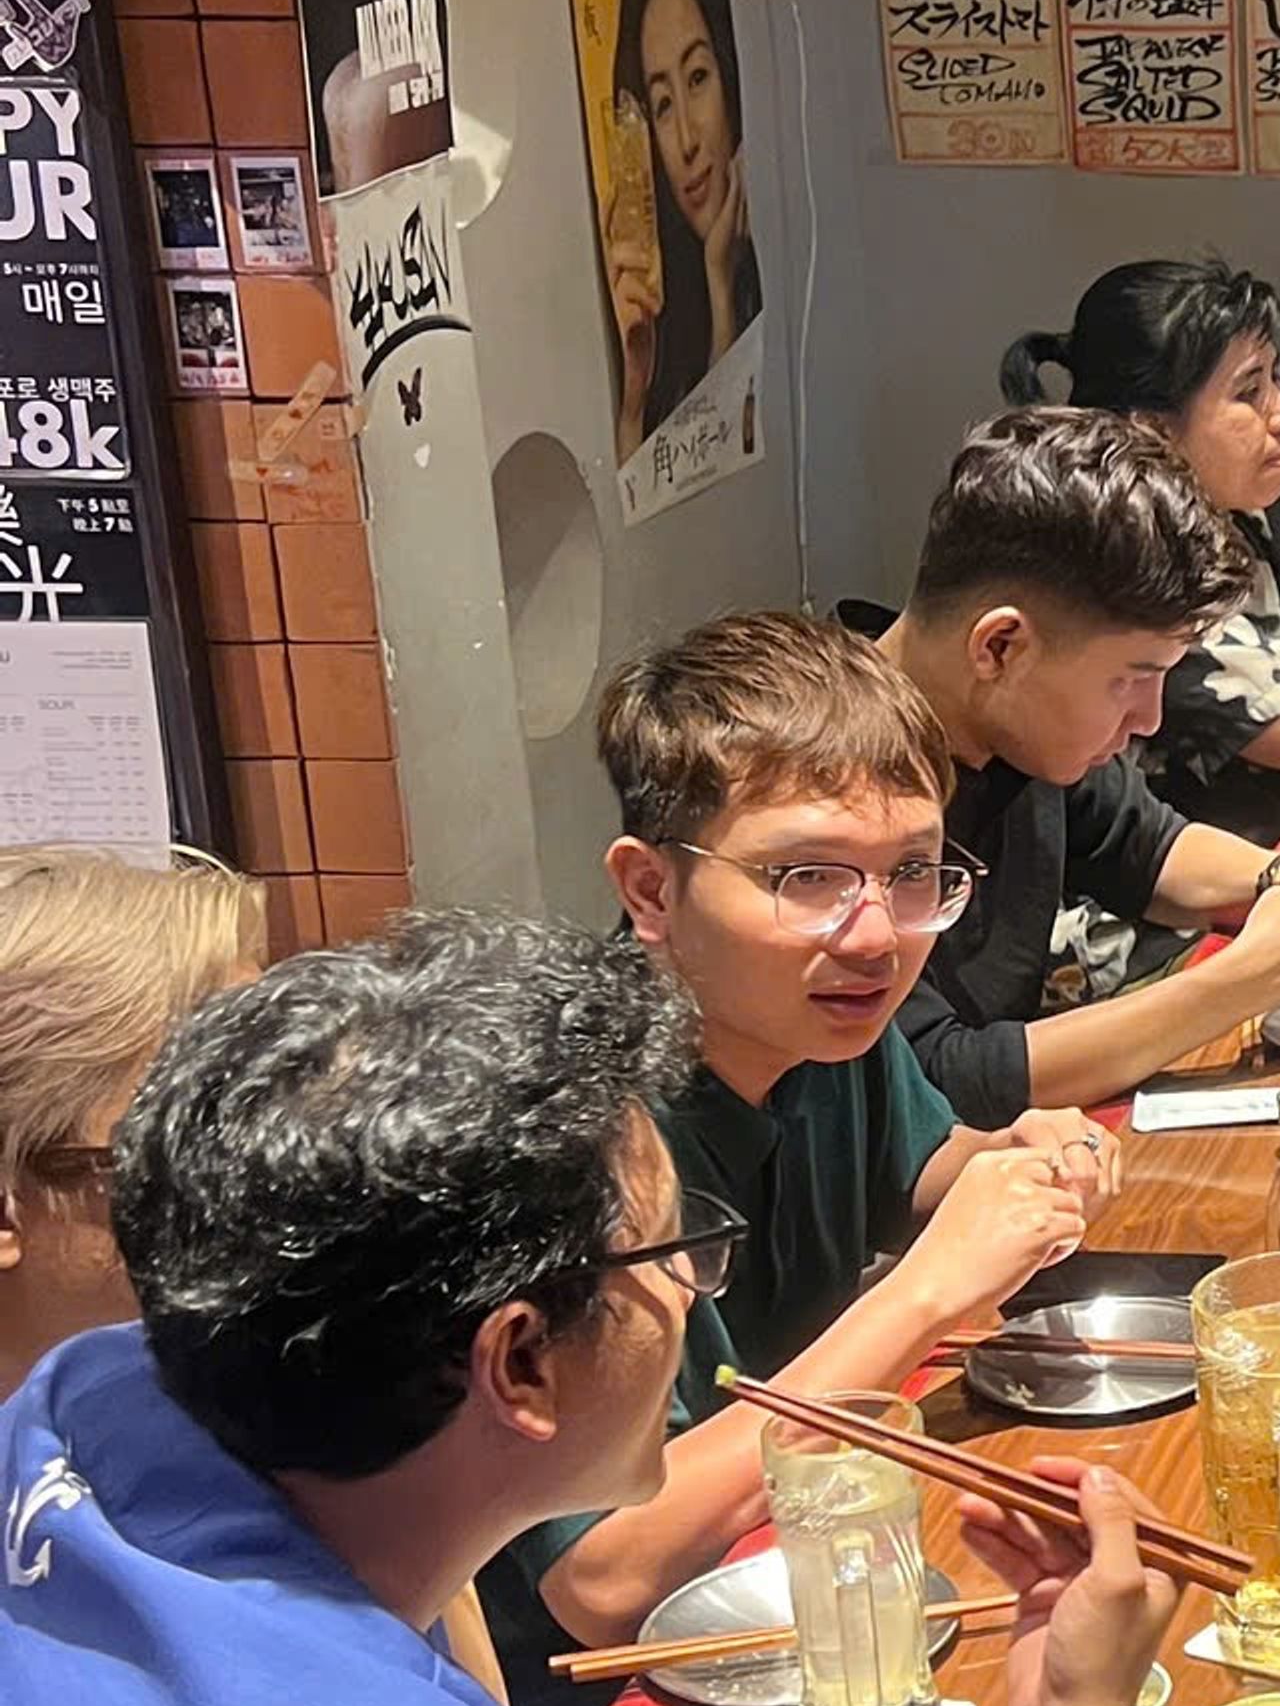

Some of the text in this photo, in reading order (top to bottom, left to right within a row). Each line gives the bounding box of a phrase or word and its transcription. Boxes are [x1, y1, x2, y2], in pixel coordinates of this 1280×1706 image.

[1080, 95, 1222, 125] SQUID
[22, 280, 105, 323] 매일
[48, 378, 116, 402] 생맥주
